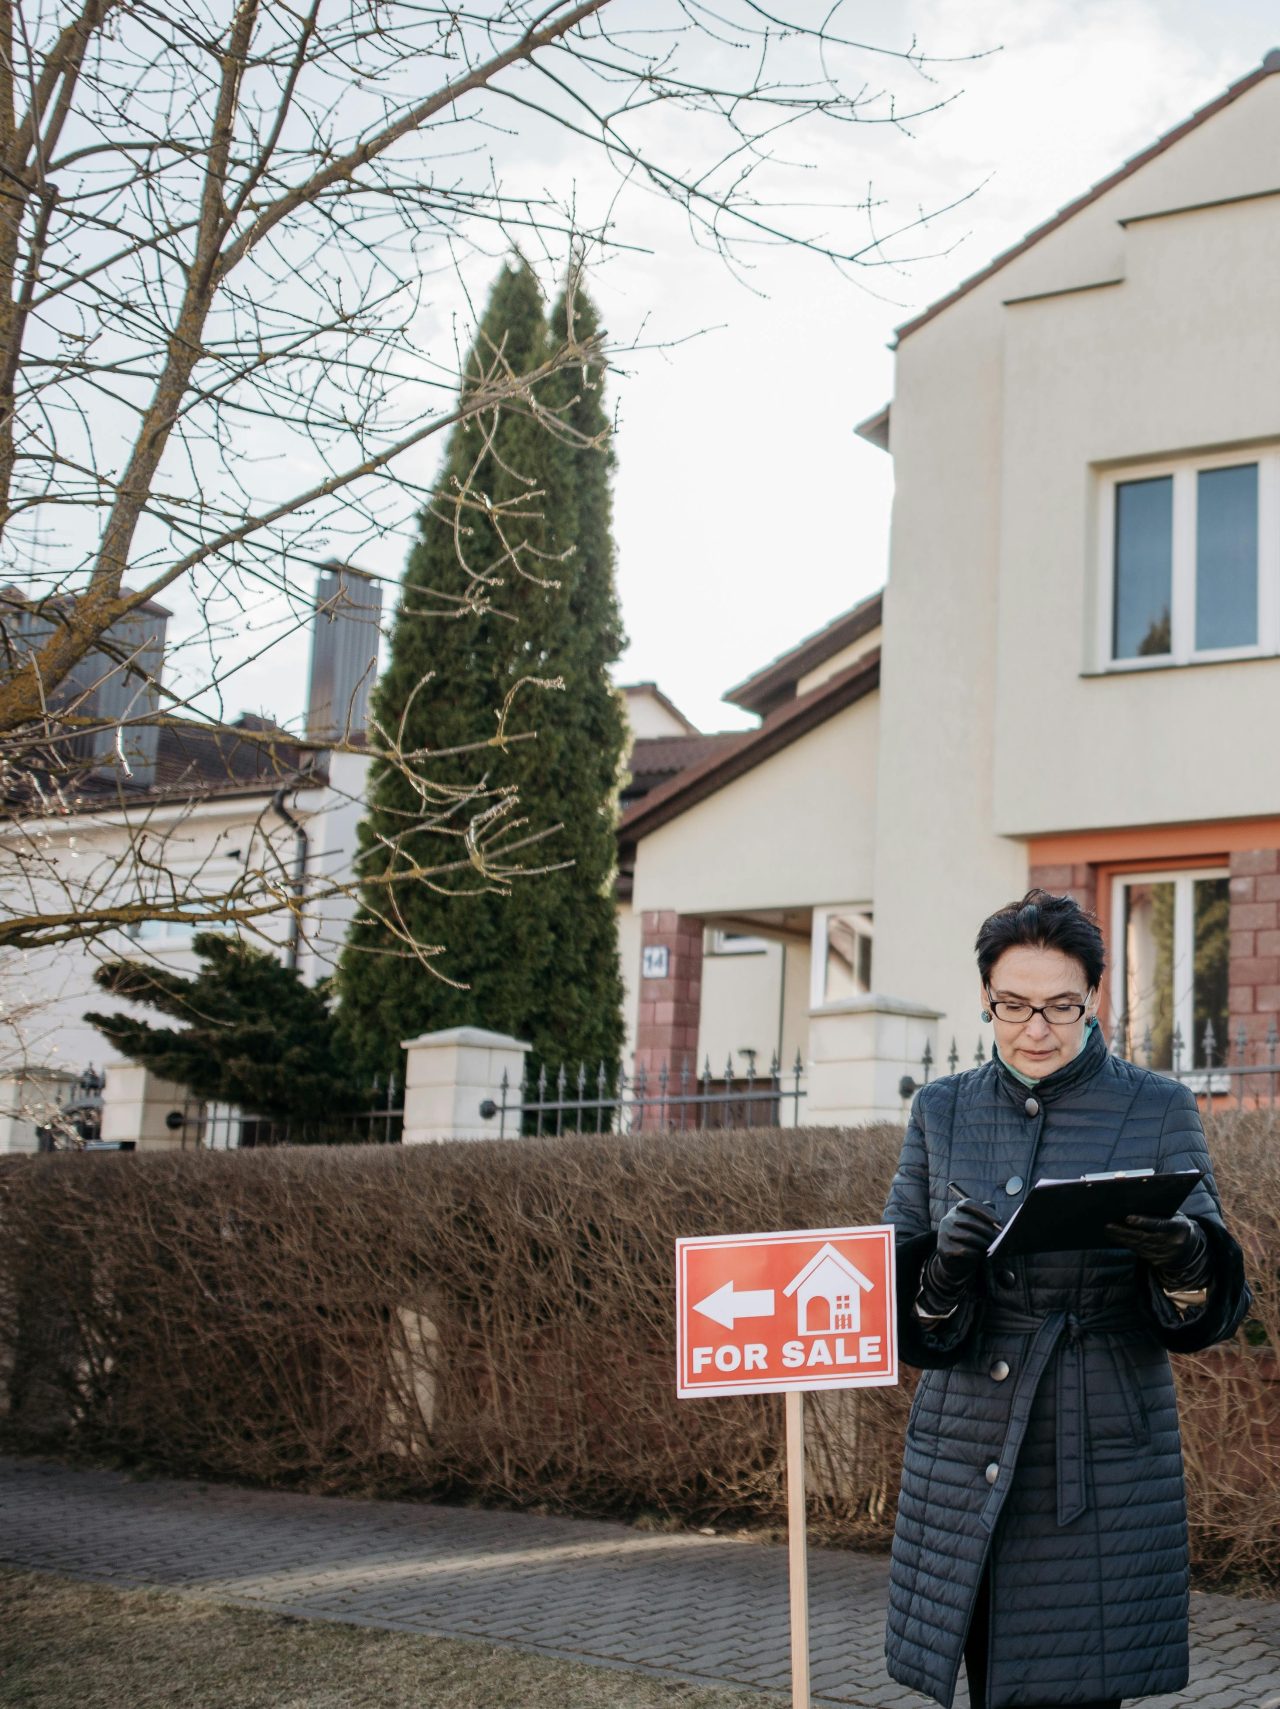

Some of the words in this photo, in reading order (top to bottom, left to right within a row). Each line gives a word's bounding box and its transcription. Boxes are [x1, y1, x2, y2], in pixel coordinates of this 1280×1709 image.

[644, 952, 664, 971] 14
[692, 1343, 768, 1374] FOR
[782, 1336, 882, 1368] SALE
